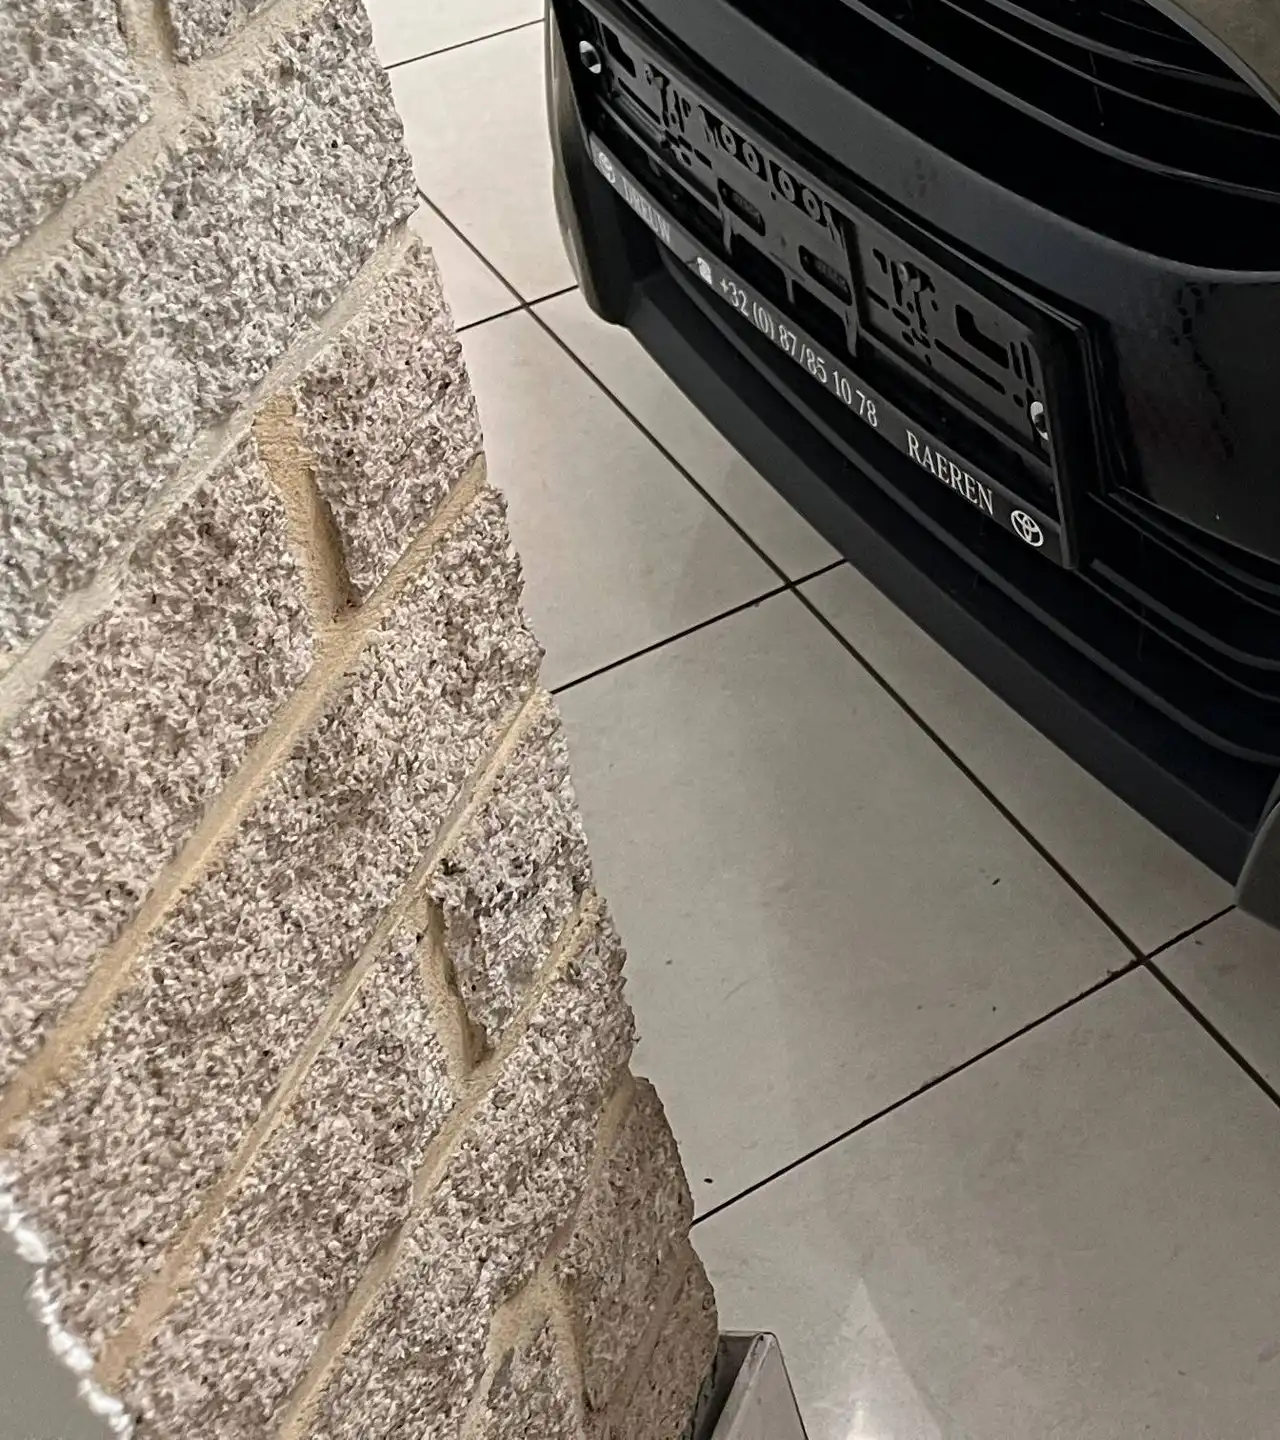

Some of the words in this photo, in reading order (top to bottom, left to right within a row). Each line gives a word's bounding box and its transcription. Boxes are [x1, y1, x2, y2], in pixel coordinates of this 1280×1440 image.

[719, 277, 749, 318] +32
[753, 301, 775, 341] (0)
[832, 370, 852, 405] 10
[855, 389, 878, 428] 78
[906, 429, 994, 516] RAEREN
